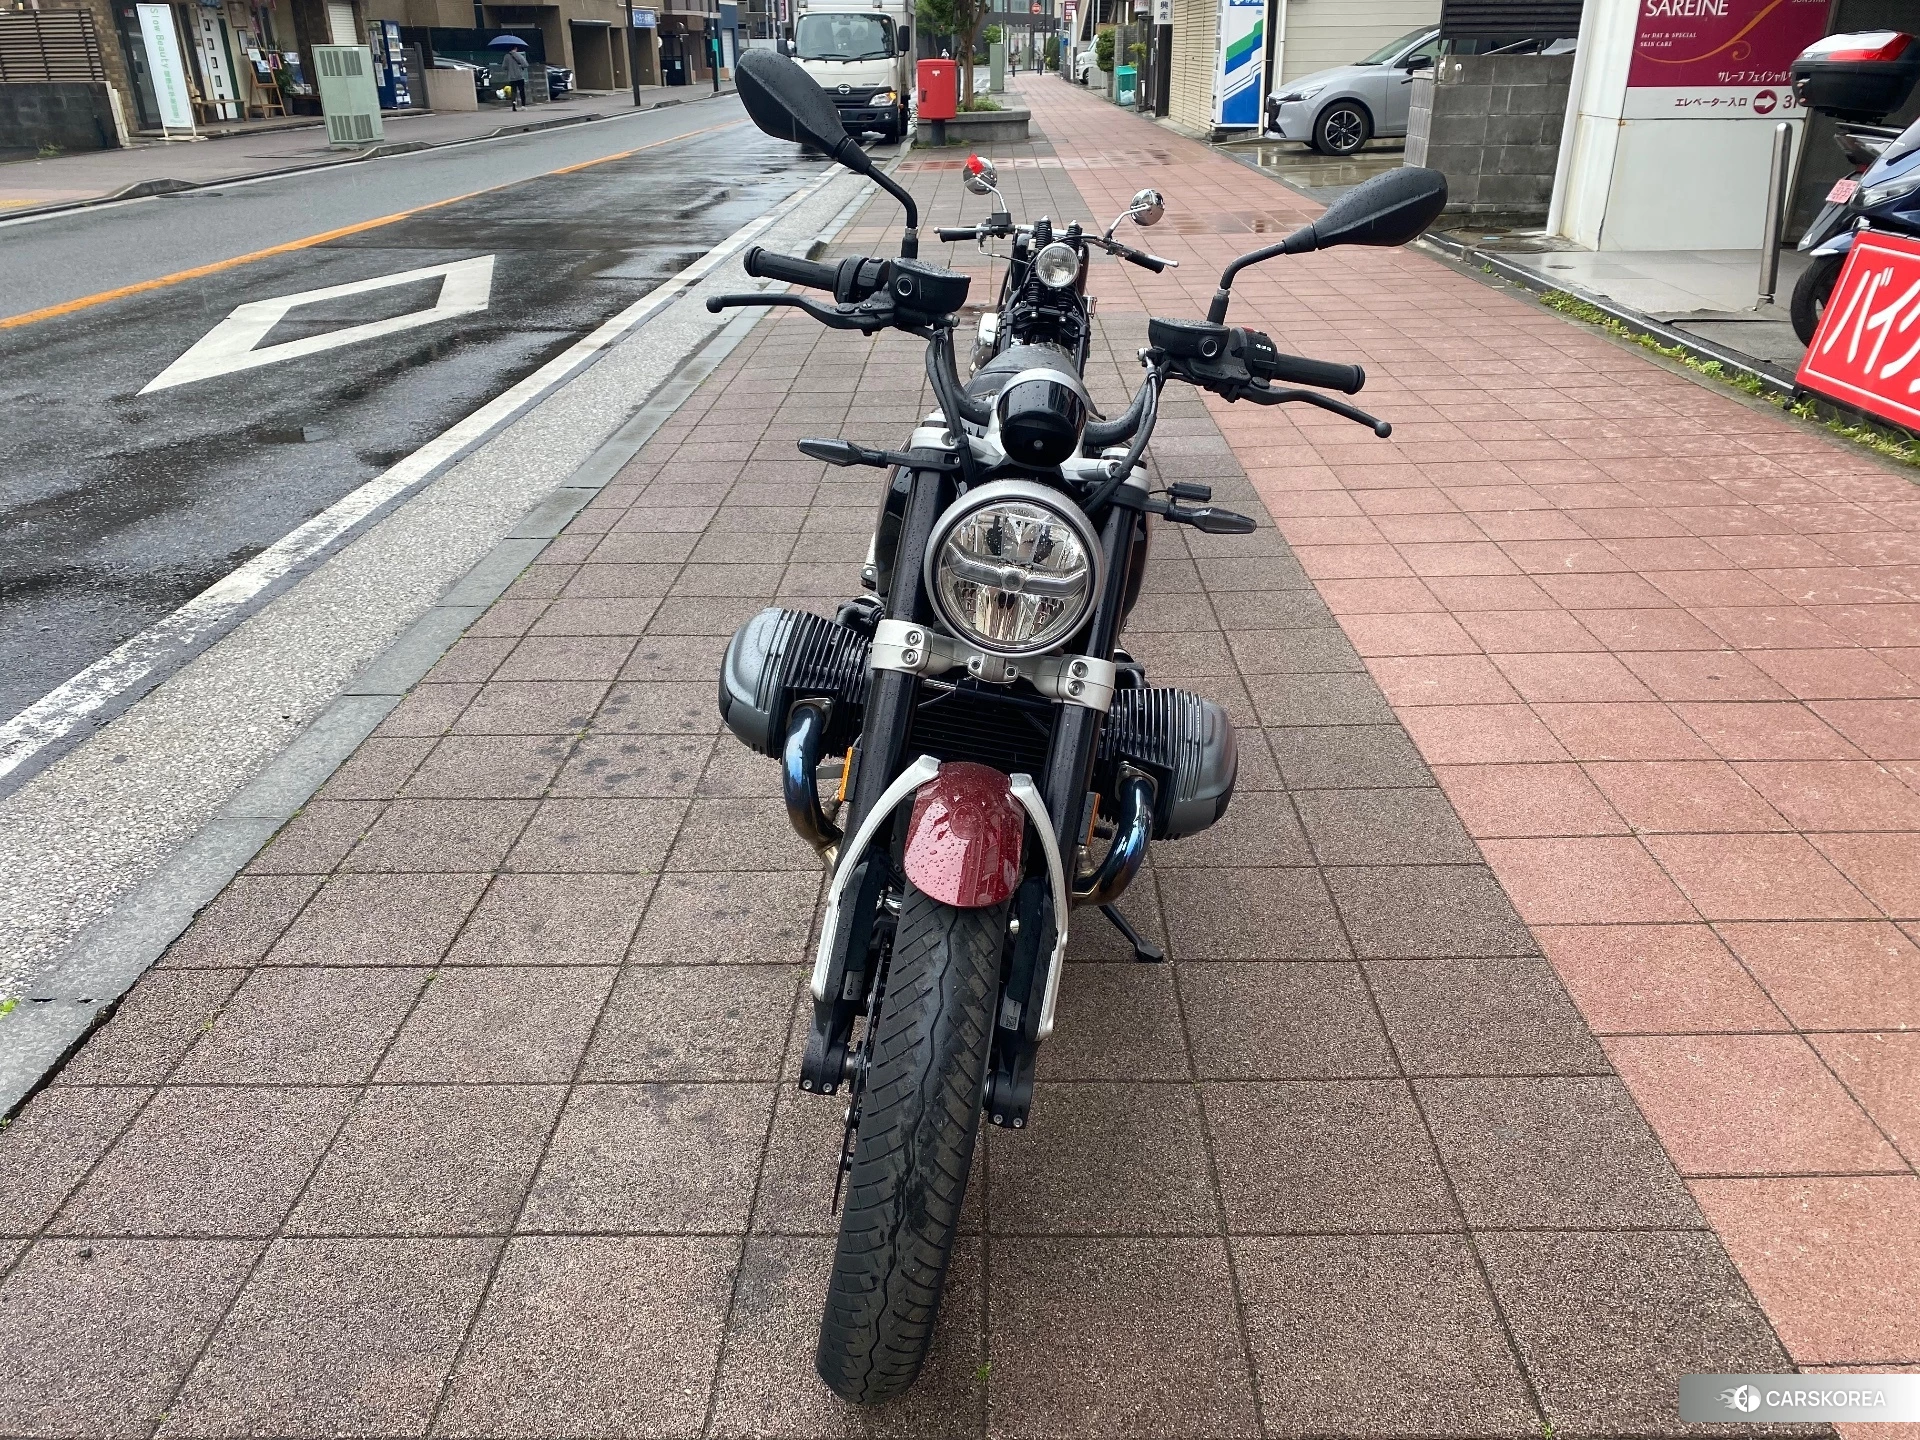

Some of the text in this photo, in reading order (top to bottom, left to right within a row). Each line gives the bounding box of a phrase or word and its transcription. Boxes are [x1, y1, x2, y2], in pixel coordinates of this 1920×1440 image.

[1645, 0, 1729, 17] SAREINE
[150, 7, 169, 69] Slow Beauty
[1674, 97, 1748, 107] エレベーター入口
